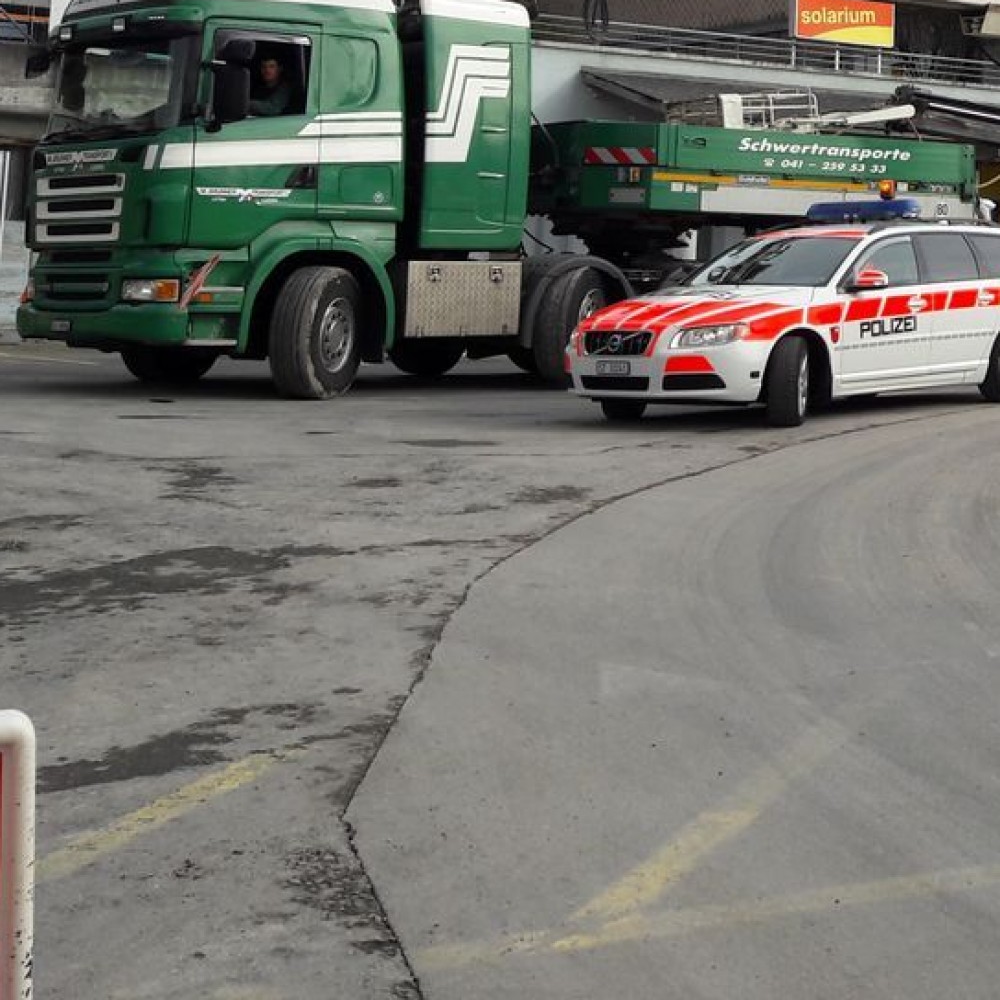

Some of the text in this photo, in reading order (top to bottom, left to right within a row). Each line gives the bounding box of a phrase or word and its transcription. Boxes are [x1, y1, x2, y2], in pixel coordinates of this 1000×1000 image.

[801, 6, 876, 25] solarium
[738, 137, 911, 161] Schwertransporte
[780, 159, 804, 168] 041
[822, 161, 847, 171] 259
[850, 163, 866, 173] 53
[869, 164, 887, 174] 33
[860, 316, 917, 338] POLIZEI
